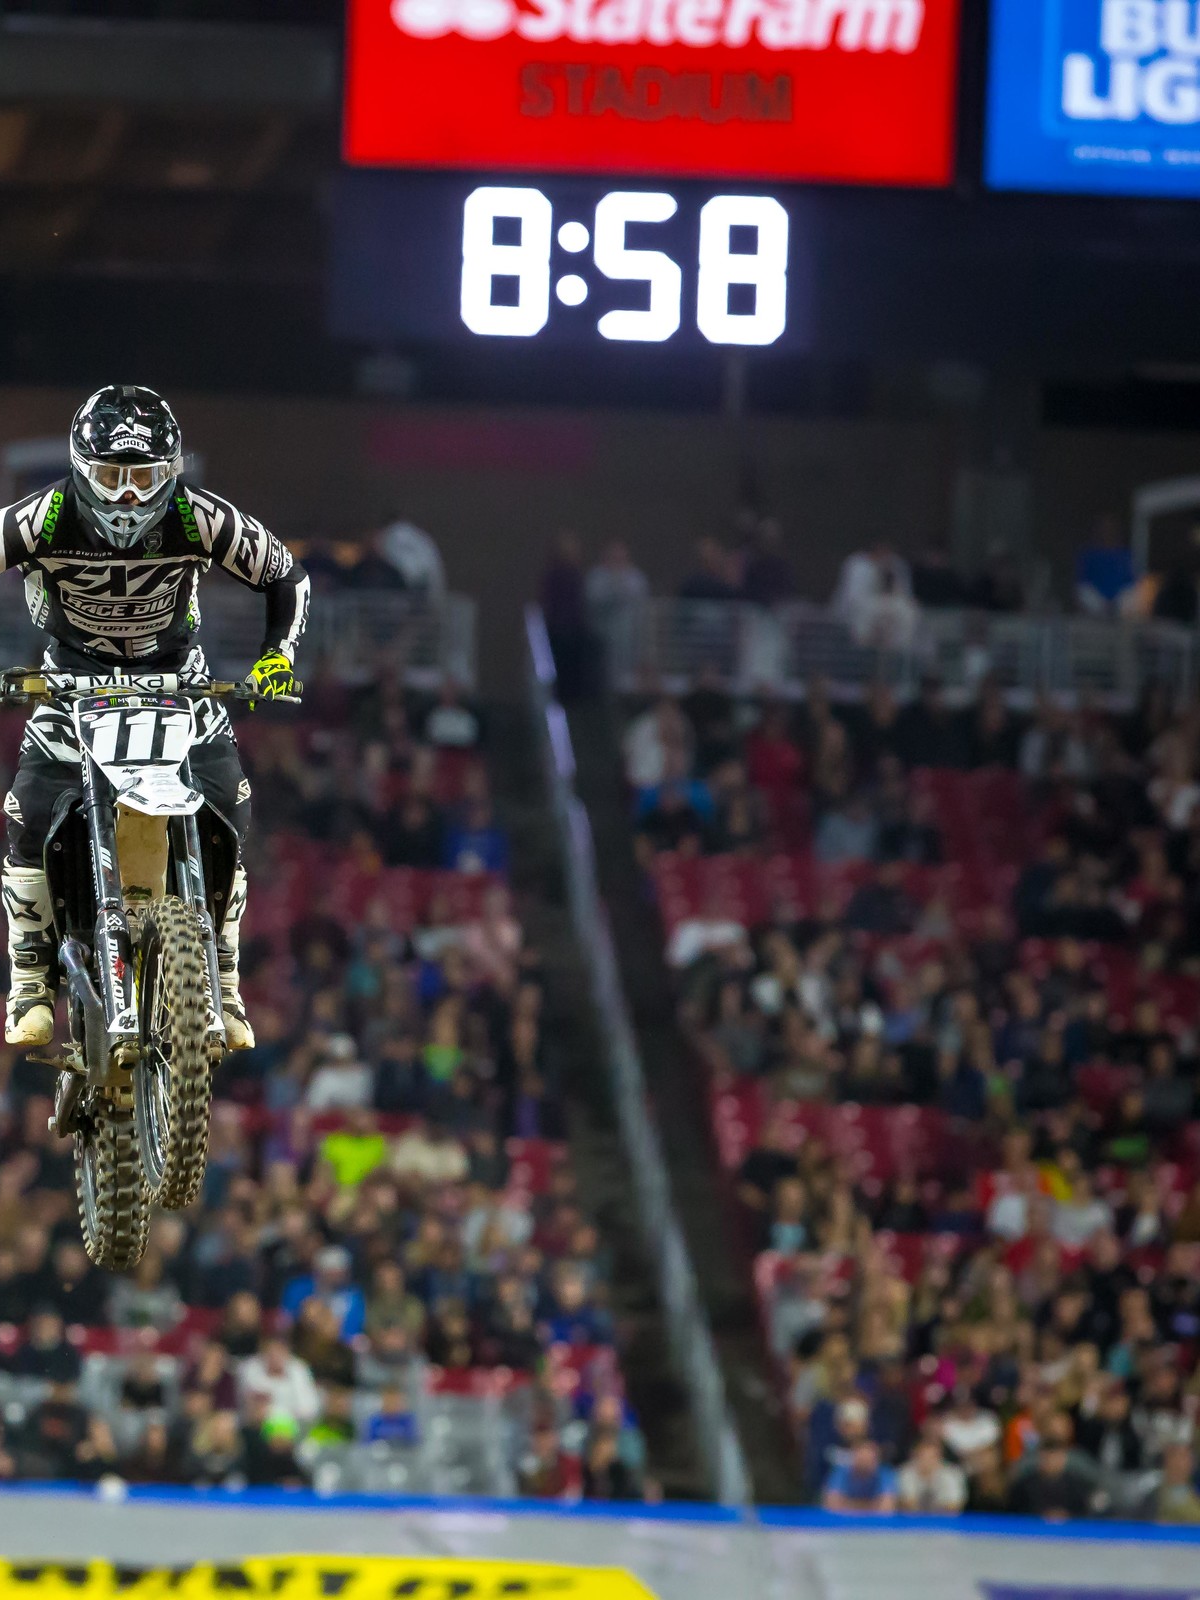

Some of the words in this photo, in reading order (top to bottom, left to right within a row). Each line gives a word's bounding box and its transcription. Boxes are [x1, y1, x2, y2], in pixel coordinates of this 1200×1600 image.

[1100, 0, 1200, 52] BU
[520, 62, 792, 123] STADIUM
[1062, 54, 1200, 124] LIG
[461, 187, 789, 345] 8:58
[116, 441, 145, 450] SHOEI
[50, 564, 188, 598] FXR
[36, 602, 50, 630] ERGY
[66, 597, 125, 618] RACE
[133, 594, 172, 614] DIV.
[71, 617, 131, 632] FACTORY
[135, 619, 168, 631] RIDE
[90, 711, 190, 762] 111
